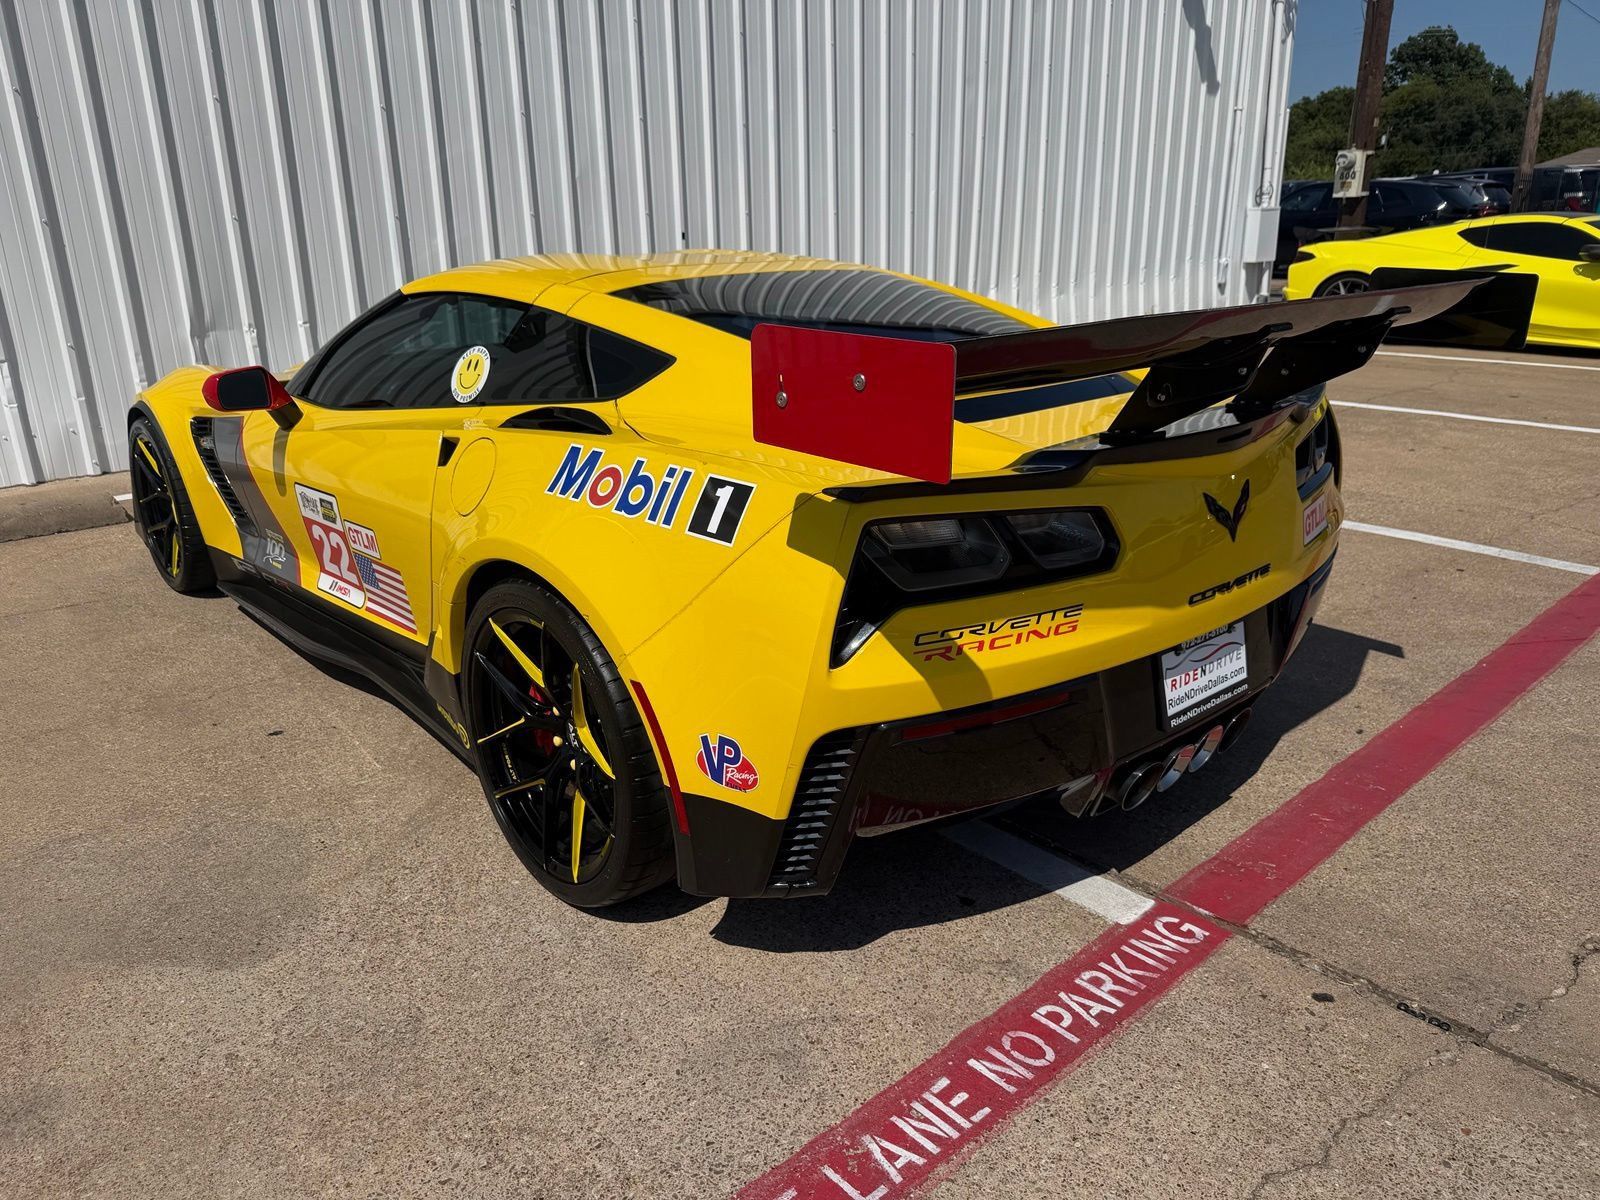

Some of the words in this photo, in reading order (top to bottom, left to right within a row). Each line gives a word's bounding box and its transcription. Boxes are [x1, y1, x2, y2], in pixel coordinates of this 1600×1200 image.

[477, 347, 489, 360] HAPPY
[546, 445, 693, 528] Mobil
[348, 527, 377, 553] GTLM
[1305, 500, 1325, 537] GTLM
[312, 525, 359, 585] 22
[1188, 563, 1271, 606] CORVETTE
[913, 620, 1080, 662] RACING
[914, 603, 1084, 646] CORVETTE
[1168, 666, 1245, 711] RideNDriveDallas.com
[1170, 648, 1242, 692] RIDENDRIVE
[1171, 683, 1249, 728] RideNDriveDallas.com
[699, 734, 742, 785] VP
[727, 767, 758, 786] Racing
[821, 1077, 992, 1200] LANE
[967, 1029, 1057, 1095] NO
[1031, 915, 1209, 1044] PARKING
